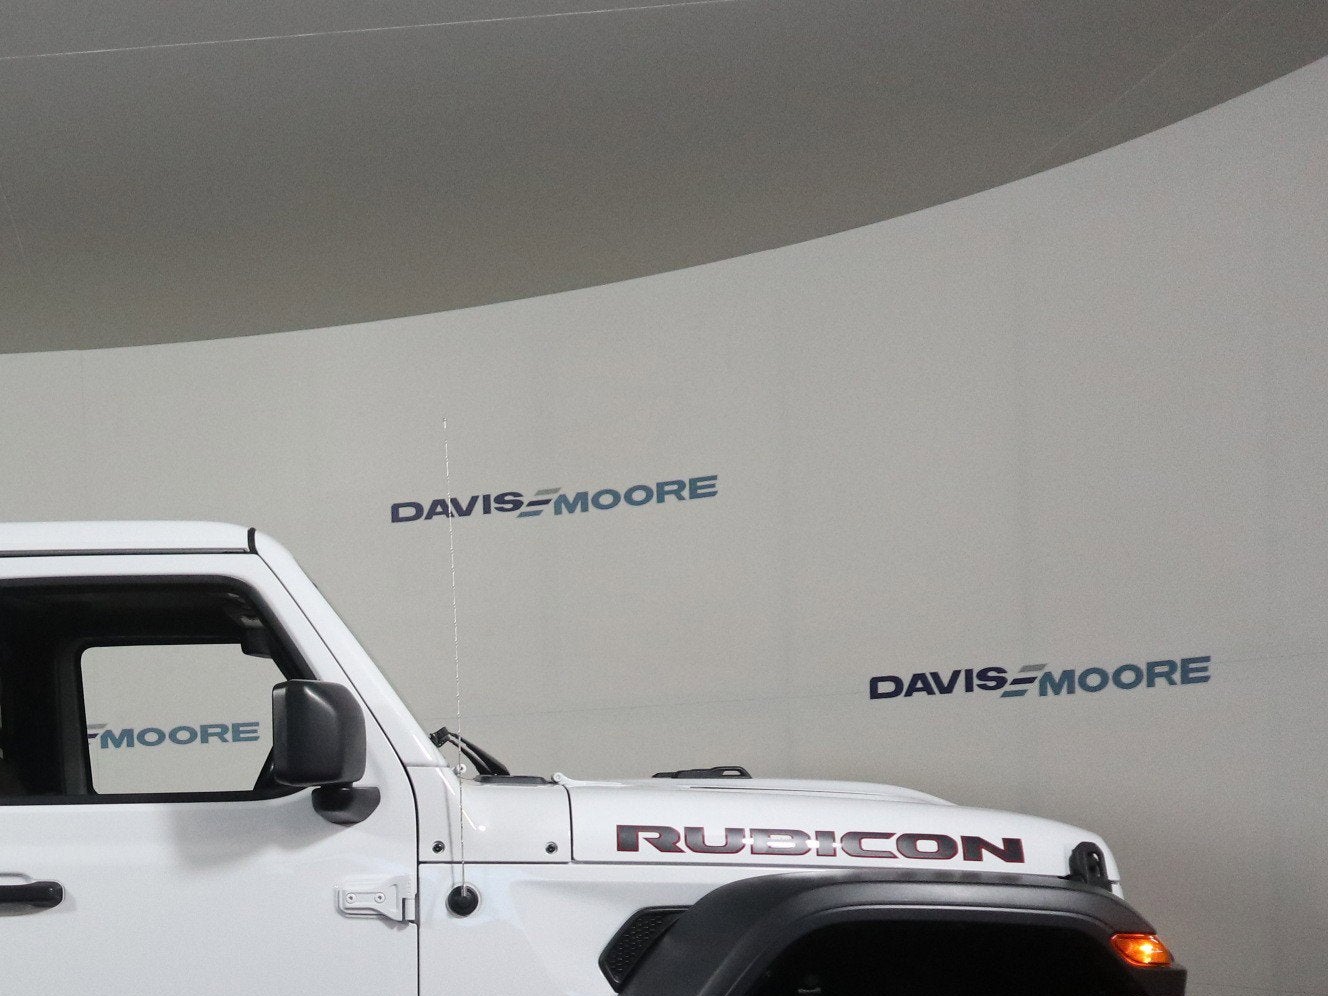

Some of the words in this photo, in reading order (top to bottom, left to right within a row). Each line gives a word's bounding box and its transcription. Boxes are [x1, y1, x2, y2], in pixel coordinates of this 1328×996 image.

[390, 491, 525, 523] DAVIS
[553, 474, 719, 516] MOORE
[869, 666, 1009, 700] DAVIS
[1038, 655, 1212, 697] MOORE
[100, 721, 260, 749] MOORE
[616, 824, 1025, 864] RUBICON
